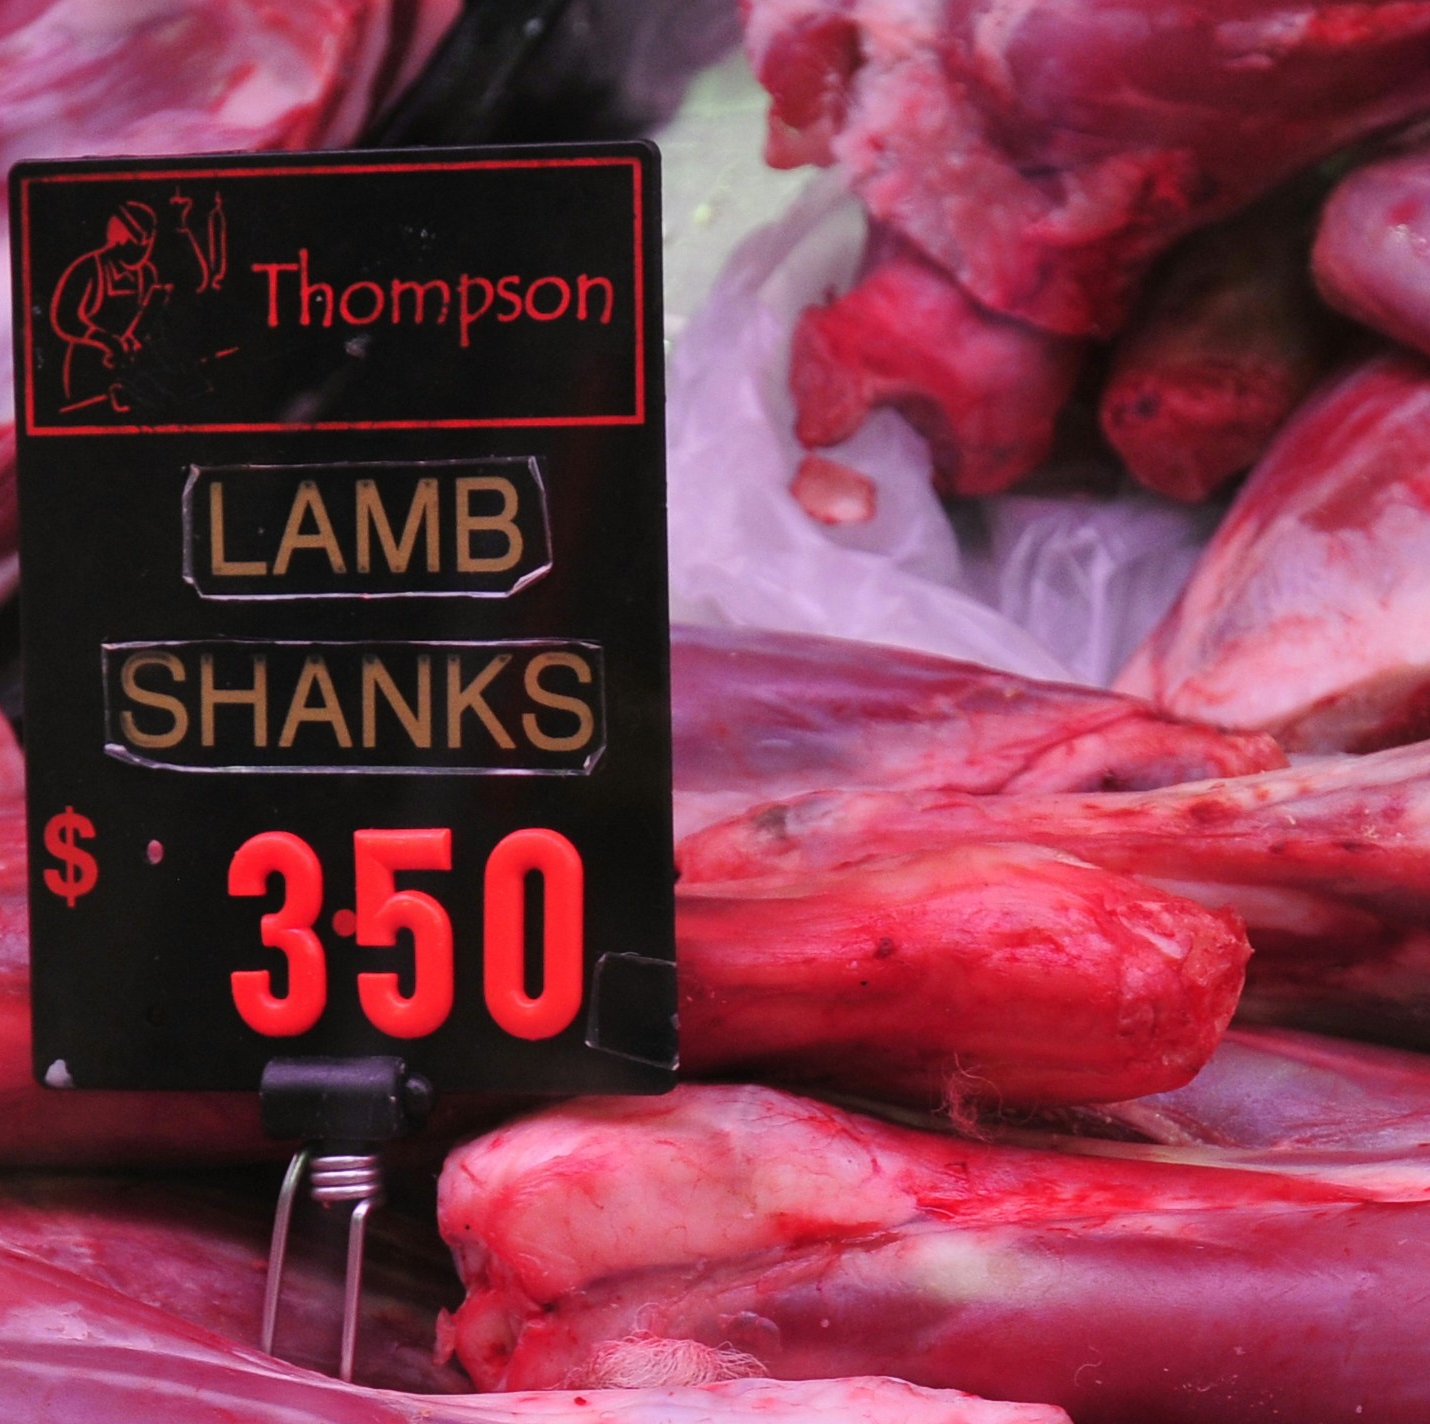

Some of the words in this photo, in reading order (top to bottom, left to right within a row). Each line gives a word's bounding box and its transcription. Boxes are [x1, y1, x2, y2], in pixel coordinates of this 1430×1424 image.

[251, 248, 614, 348] Thompson
[208, 476, 524, 577] LAMB
[119, 650, 594, 753] SHANKS
[42, 805, 100, 908] $
